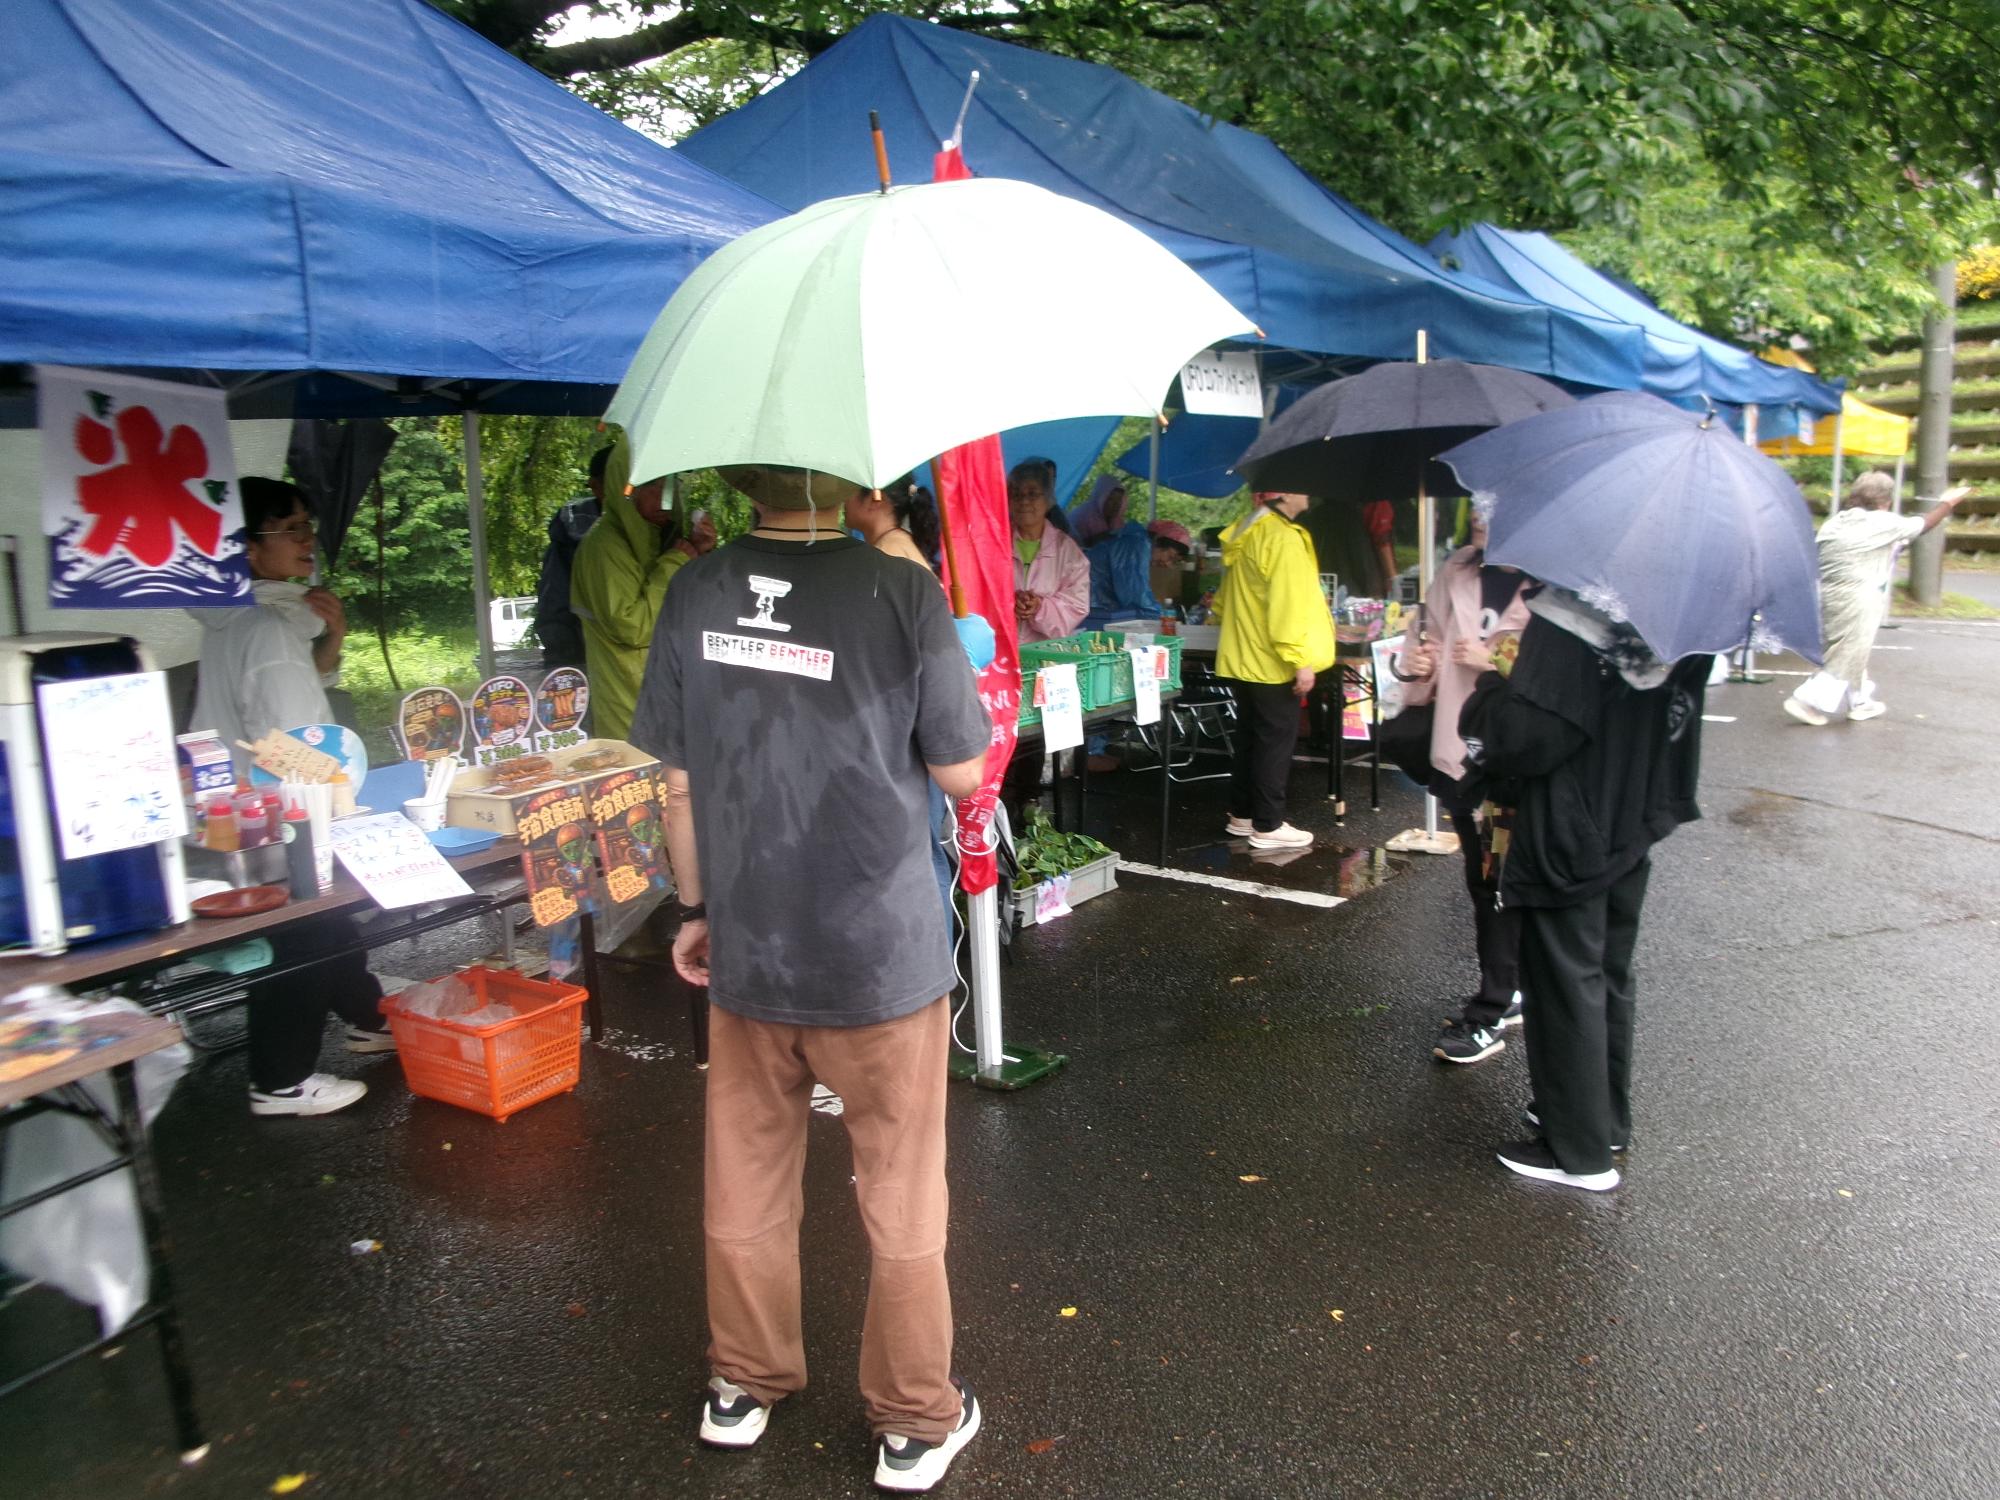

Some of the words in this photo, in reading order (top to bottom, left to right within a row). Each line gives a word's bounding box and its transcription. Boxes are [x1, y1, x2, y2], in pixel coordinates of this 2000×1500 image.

[75, 405, 222, 567] 氷
[706, 634, 765, 655] BENTLER
[769, 643, 831, 666] BENTLER
[487, 679, 514, 694] UFO
